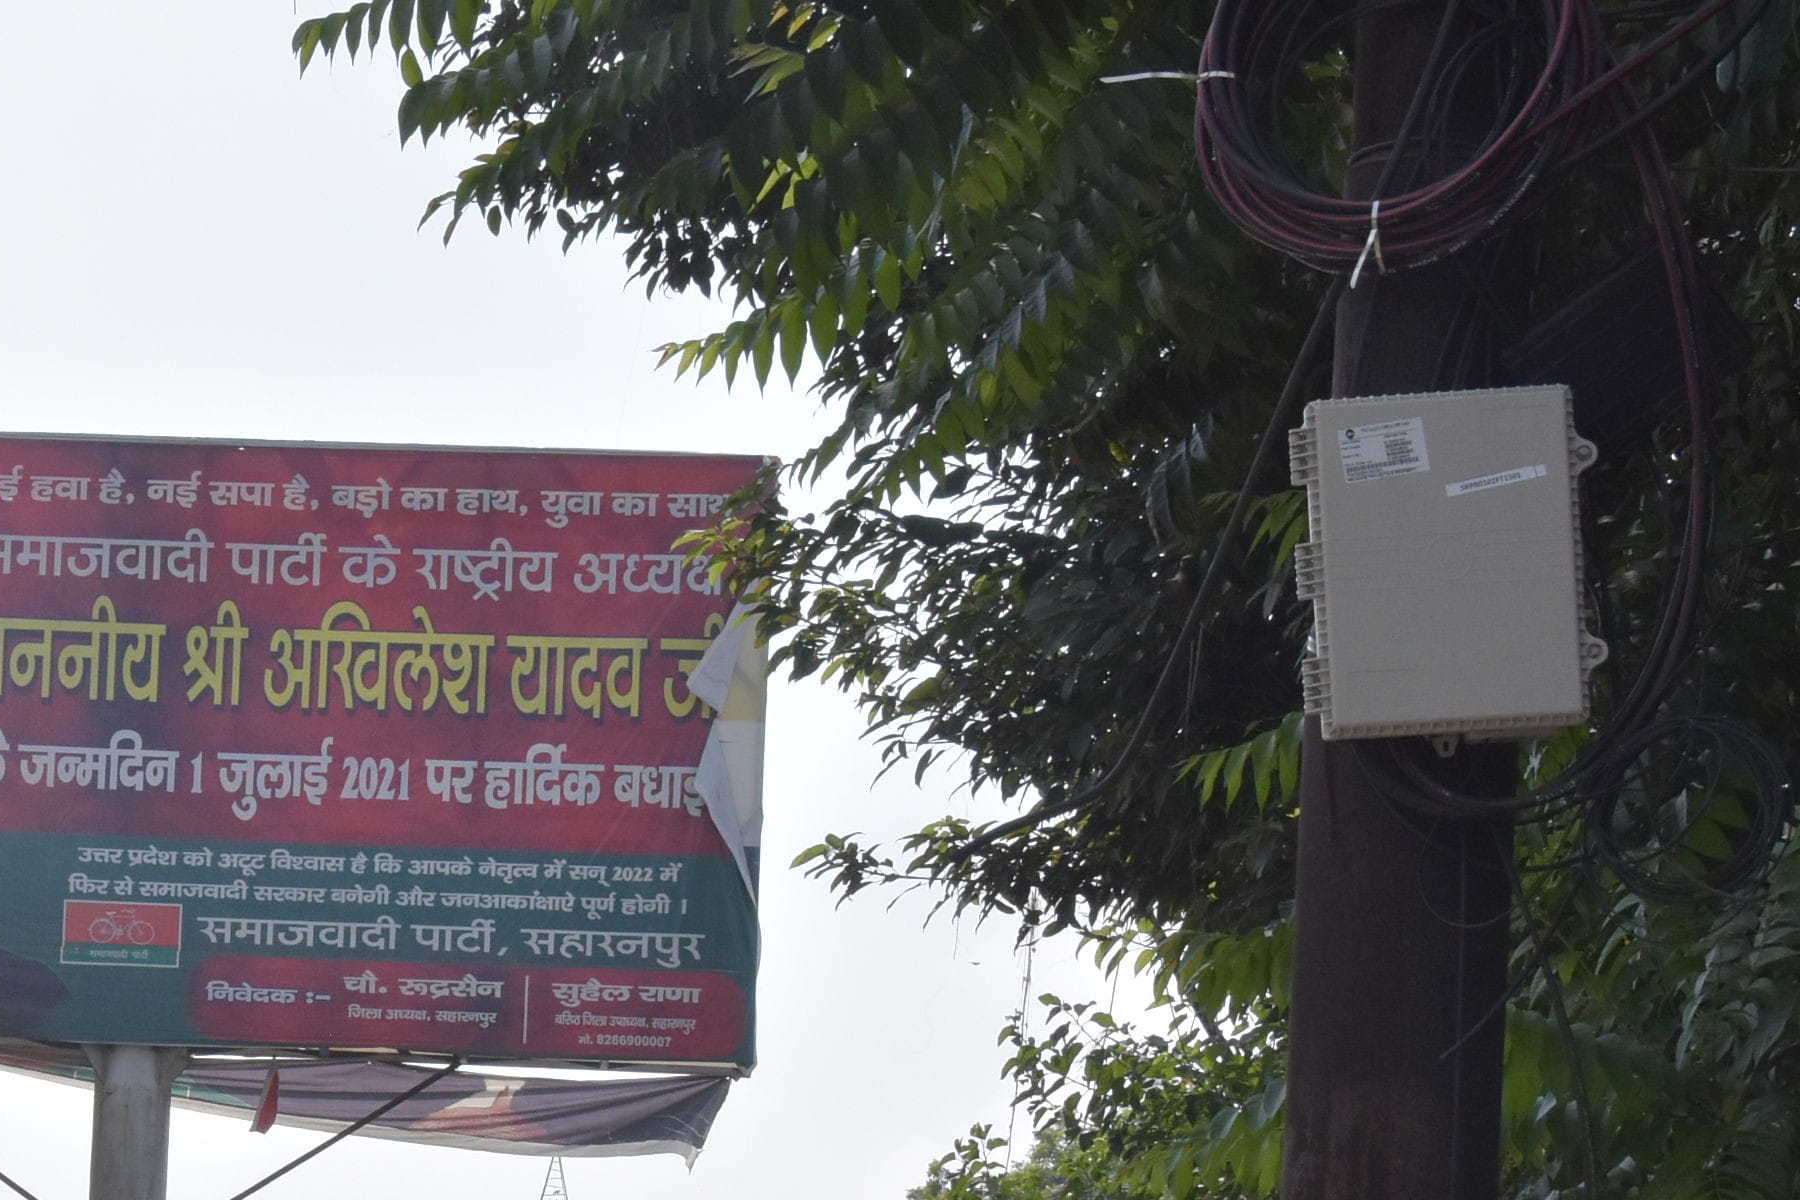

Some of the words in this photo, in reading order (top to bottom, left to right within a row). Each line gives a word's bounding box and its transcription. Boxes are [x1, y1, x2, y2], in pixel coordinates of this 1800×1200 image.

[30, 475, 91, 502] हवा
[99, 468, 134, 505] है,
[147, 470, 201, 509] नई
[209, 481, 275, 507] सपा
[283, 474, 319, 511] है,
[332, 477, 392, 518] बड़ो
[401, 486, 448, 513] का
[456, 488, 527, 516] हाथ,
[540, 490, 603, 529] युवा
[611, 492, 660, 517] का
[225, 531, 327, 586] पार्टी
[338, 534, 400, 589] के
[413, 537, 558, 601] राष्ट्रीय
[183, 599, 249, 706] श्री
[264, 600, 495, 715] अखिलेश
[507, 635, 648, 719] यादव
[18, 729, 180, 793] जन्मदिन
[190, 751, 203, 794] 1
[217, 737, 333, 821] जुलाई
[339, 756, 410, 801] 2021
[425, 759, 478, 803] पर
[484, 743, 605, 809] हार्दिक
[78, 846, 121, 863] उत्तर
[128, 844, 177, 867] प्रदेश
[183, 847, 212, 867] को
[218, 852, 266, 876] अटूट
[270, 849, 345, 872] विश्वास
[350, 851, 369, 874] है
[374, 852, 403, 874] कि
[407, 856, 473, 876] आपके
[478, 856, 541, 884] नेतृत्व
[544, 858, 567, 879] में
[612, 866, 653, 882] 2022
[659, 862, 683, 883] में
[68, 873, 111, 894] फिर
[113, 876, 134, 896] से
[139, 880, 248, 901] समाजवादी
[253, 885, 324, 903] सरकार
[330, 884, 390, 906] बनेगी
[395, 885, 440, 907] और
[581, 891, 616, 920] पूर्ण
[621, 893, 671, 915] होगी
[197, 915, 401, 951] समाजवादी
[410, 918, 509, 956] पार्टी,
[520, 928, 706, 968] सहारनपुर
[206, 980, 298, 1005] निवेदक
[343, 969, 388, 994] चौ.
[552, 977, 633, 1008] सुहैल
[638, 986, 702, 1004] राणा
[348, 1004, 383, 1019] जिला
[435, 1010, 498, 1029] सहारनपुर
